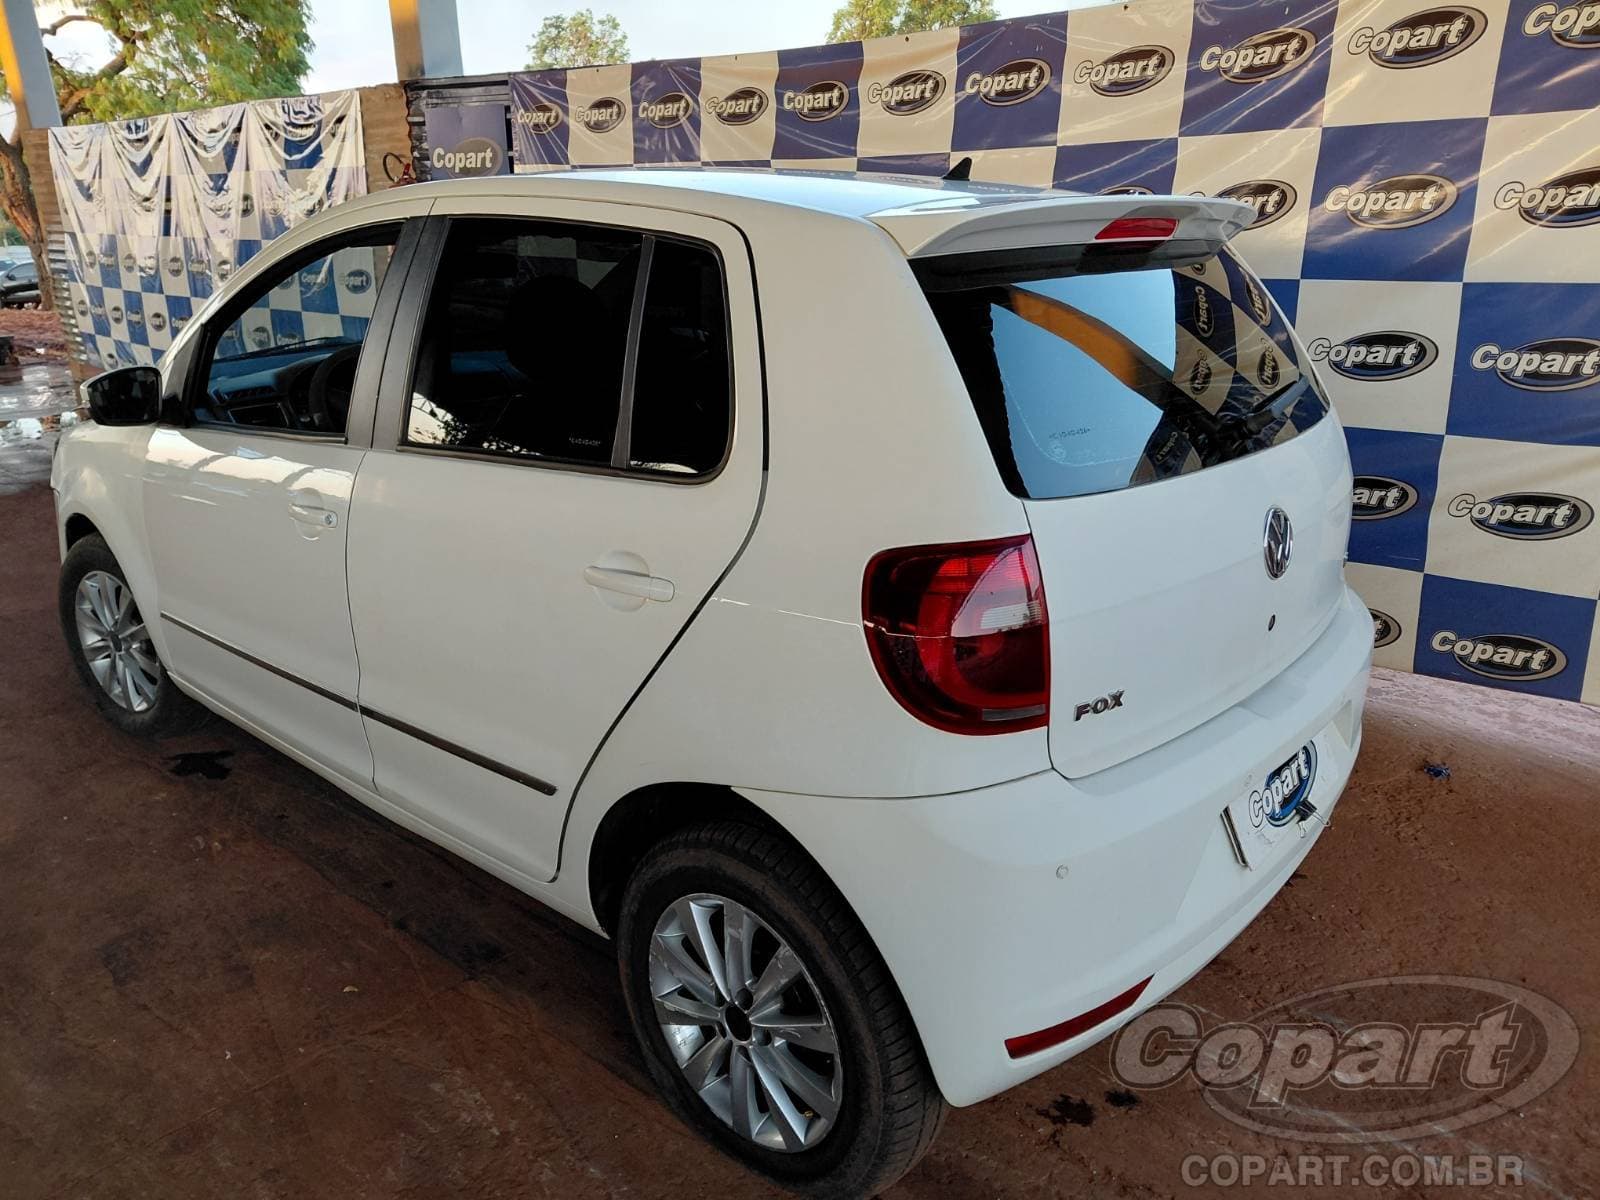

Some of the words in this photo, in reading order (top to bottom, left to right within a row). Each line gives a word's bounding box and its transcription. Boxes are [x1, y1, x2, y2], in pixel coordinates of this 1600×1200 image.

[1347, 15, 1469, 57] Copart
[1522, 2, 1600, 38] Cop
[1074, 51, 1162, 88] Copart
[1200, 36, 1302, 73] Copart
[868, 75, 937, 105] Copart
[965, 63, 1042, 97] Copart
[517, 108, 559, 124] Copart
[575, 102, 619, 124] Copart
[638, 96, 686, 120] Copart
[705, 93, 760, 118] Copart
[783, 86, 843, 113] Copart
[432, 147, 492, 173] Copart
[1325, 182, 1443, 217] Copart
[1494, 181, 1600, 216] Copar
[1308, 337, 1423, 369] Copart
[1470, 343, 1600, 379] Copart
[1352, 487, 1402, 510] art
[1448, 493, 1577, 528] Copart
[1431, 630, 1552, 672] Copart
[1073, 689, 1125, 721] FOX
[1248, 748, 1309, 828] Copart
